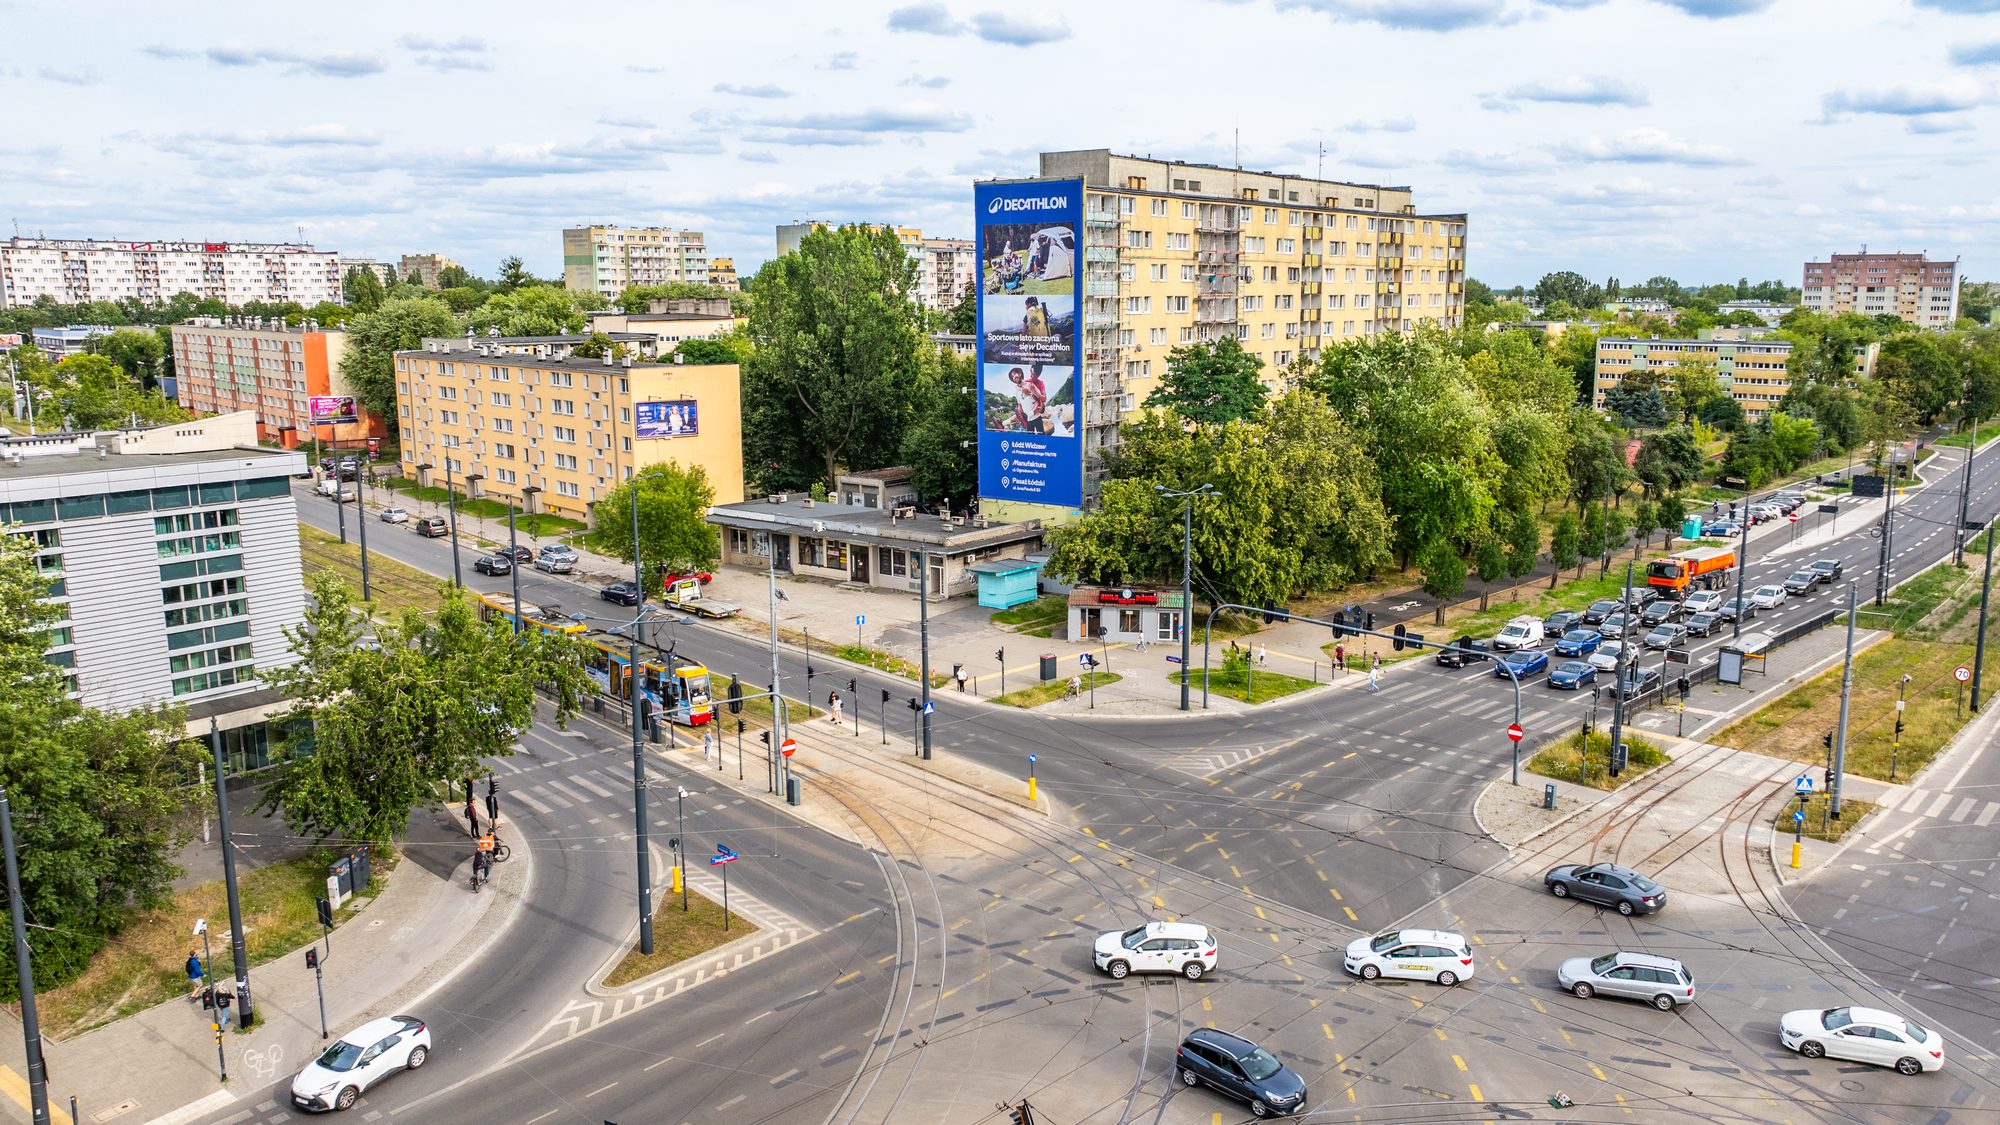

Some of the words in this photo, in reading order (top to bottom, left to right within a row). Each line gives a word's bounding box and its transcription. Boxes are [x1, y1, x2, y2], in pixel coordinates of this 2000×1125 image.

[1003, 196, 1067, 211] DECATHLON
[988, 333, 1019, 342] Sportowe
[1020, 333, 1032, 341] lato
[1032, 335, 1060, 343] zaczyna
[1019, 343, 1028, 351] się
[1036, 343, 1070, 351] Decathlon
[1012, 459, 1047, 468] Manufaktura
[1012, 477, 1027, 485] Pasaż
[1957, 670, 1969, 678] 70
